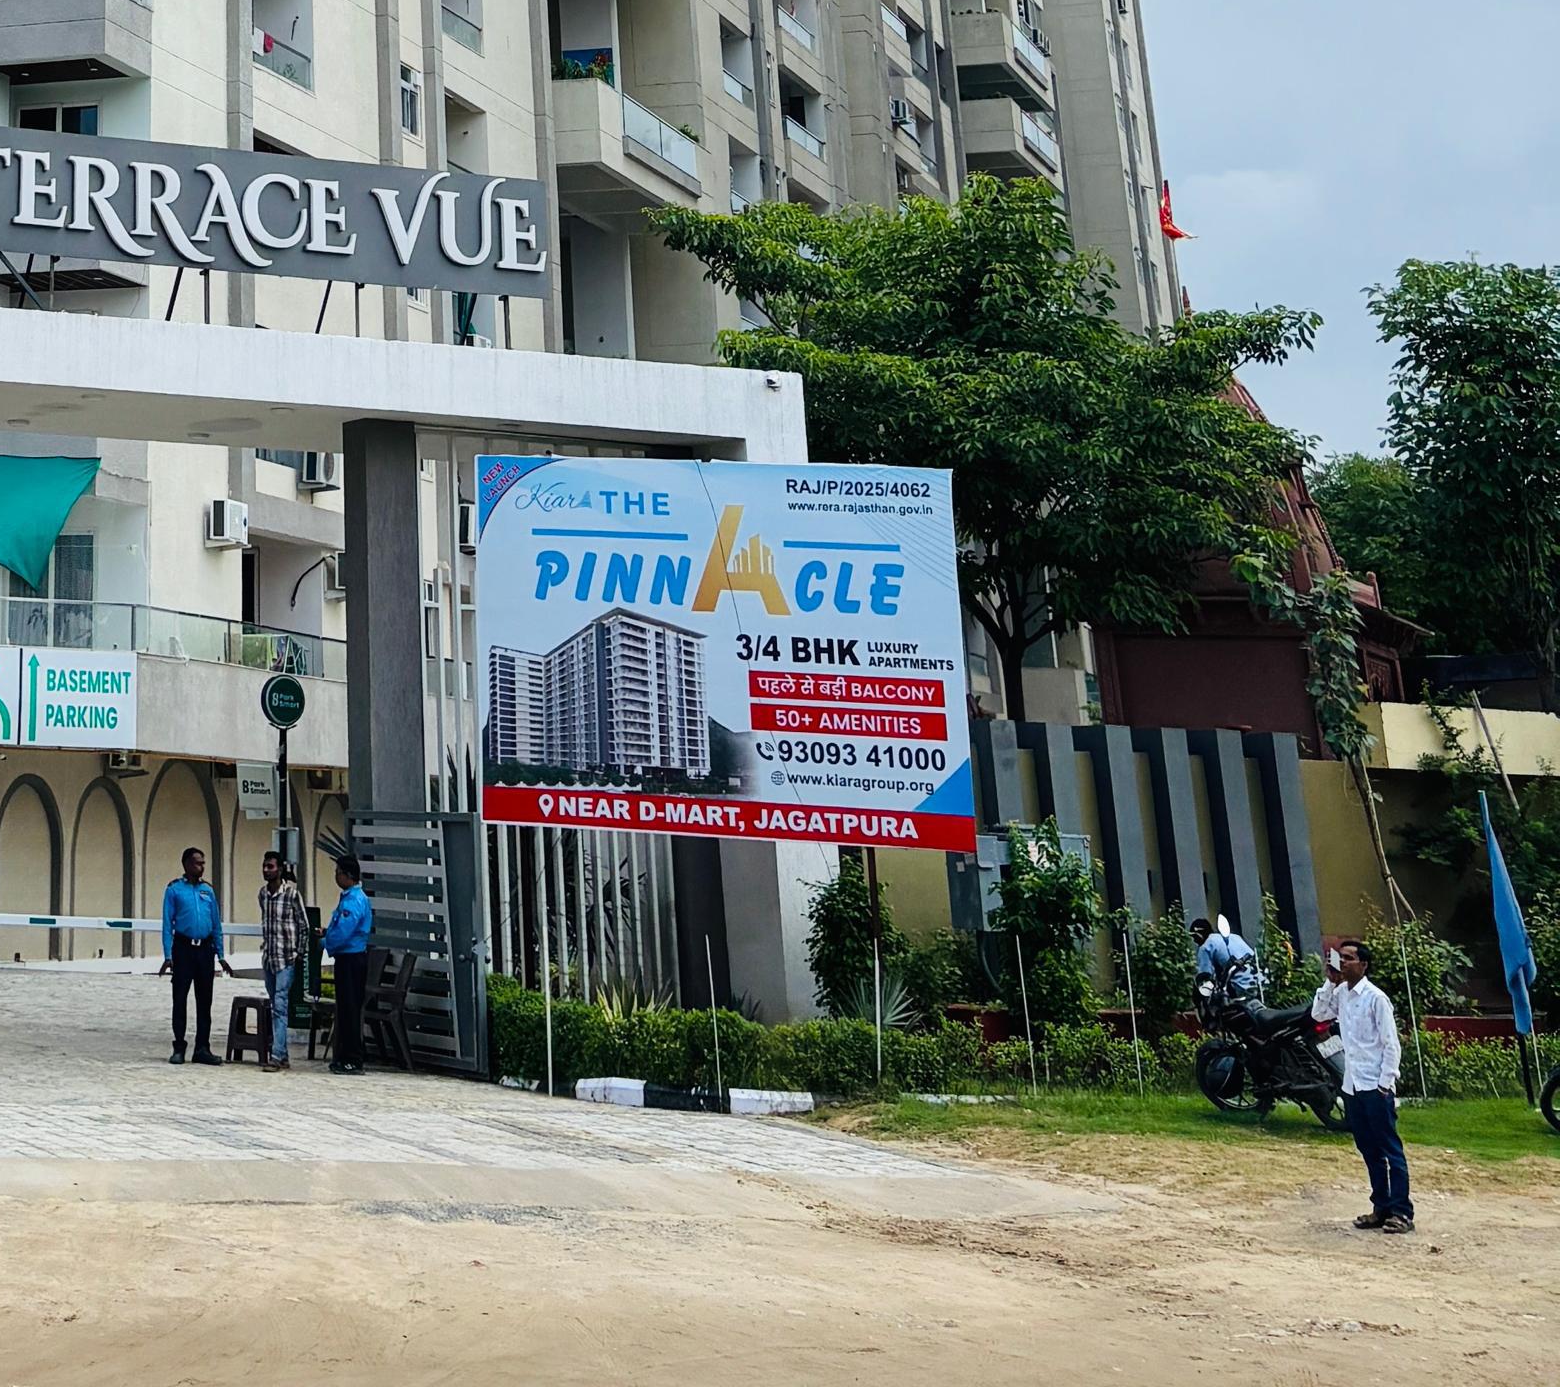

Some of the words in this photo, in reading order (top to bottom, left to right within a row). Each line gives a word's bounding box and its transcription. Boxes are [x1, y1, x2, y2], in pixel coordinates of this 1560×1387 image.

[369, 170, 548, 273] VUE
[482, 461, 504, 485] NEW
[483, 463, 521, 503] LAUNCH
[785, 478, 931, 498] RAJ/P/2025/4062
[599, 490, 671, 516] THE
[787, 501, 933, 517] www.rera.rajasthan.gov.in
[534, 504, 906, 617] PINNACLE
[735, 633, 781, 662] 3/4
[791, 636, 861, 667] BHK
[867, 641, 919, 655] LUXURY
[868, 655, 954, 671] APARTMENTS
[46, 668, 132, 695] BASEMENT
[757, 674, 796, 695] पहले
[799, 675, 815, 695] से
[819, 676, 847, 700] बड़ी
[851, 683, 935, 701] BALCONY
[45, 704, 118, 730] PARKING
[775, 709, 813, 728] 50+
[819, 712, 921, 734] AMENITIES
[777, 739, 857, 766] 93093
[866, 744, 946, 771] 41000
[788, 774, 934, 795] www.kiaragroup.org
[558, 796, 631, 821] NEAR
[639, 801, 745, 832] D-MART,
[753, 808, 919, 840] JAGATPURA
